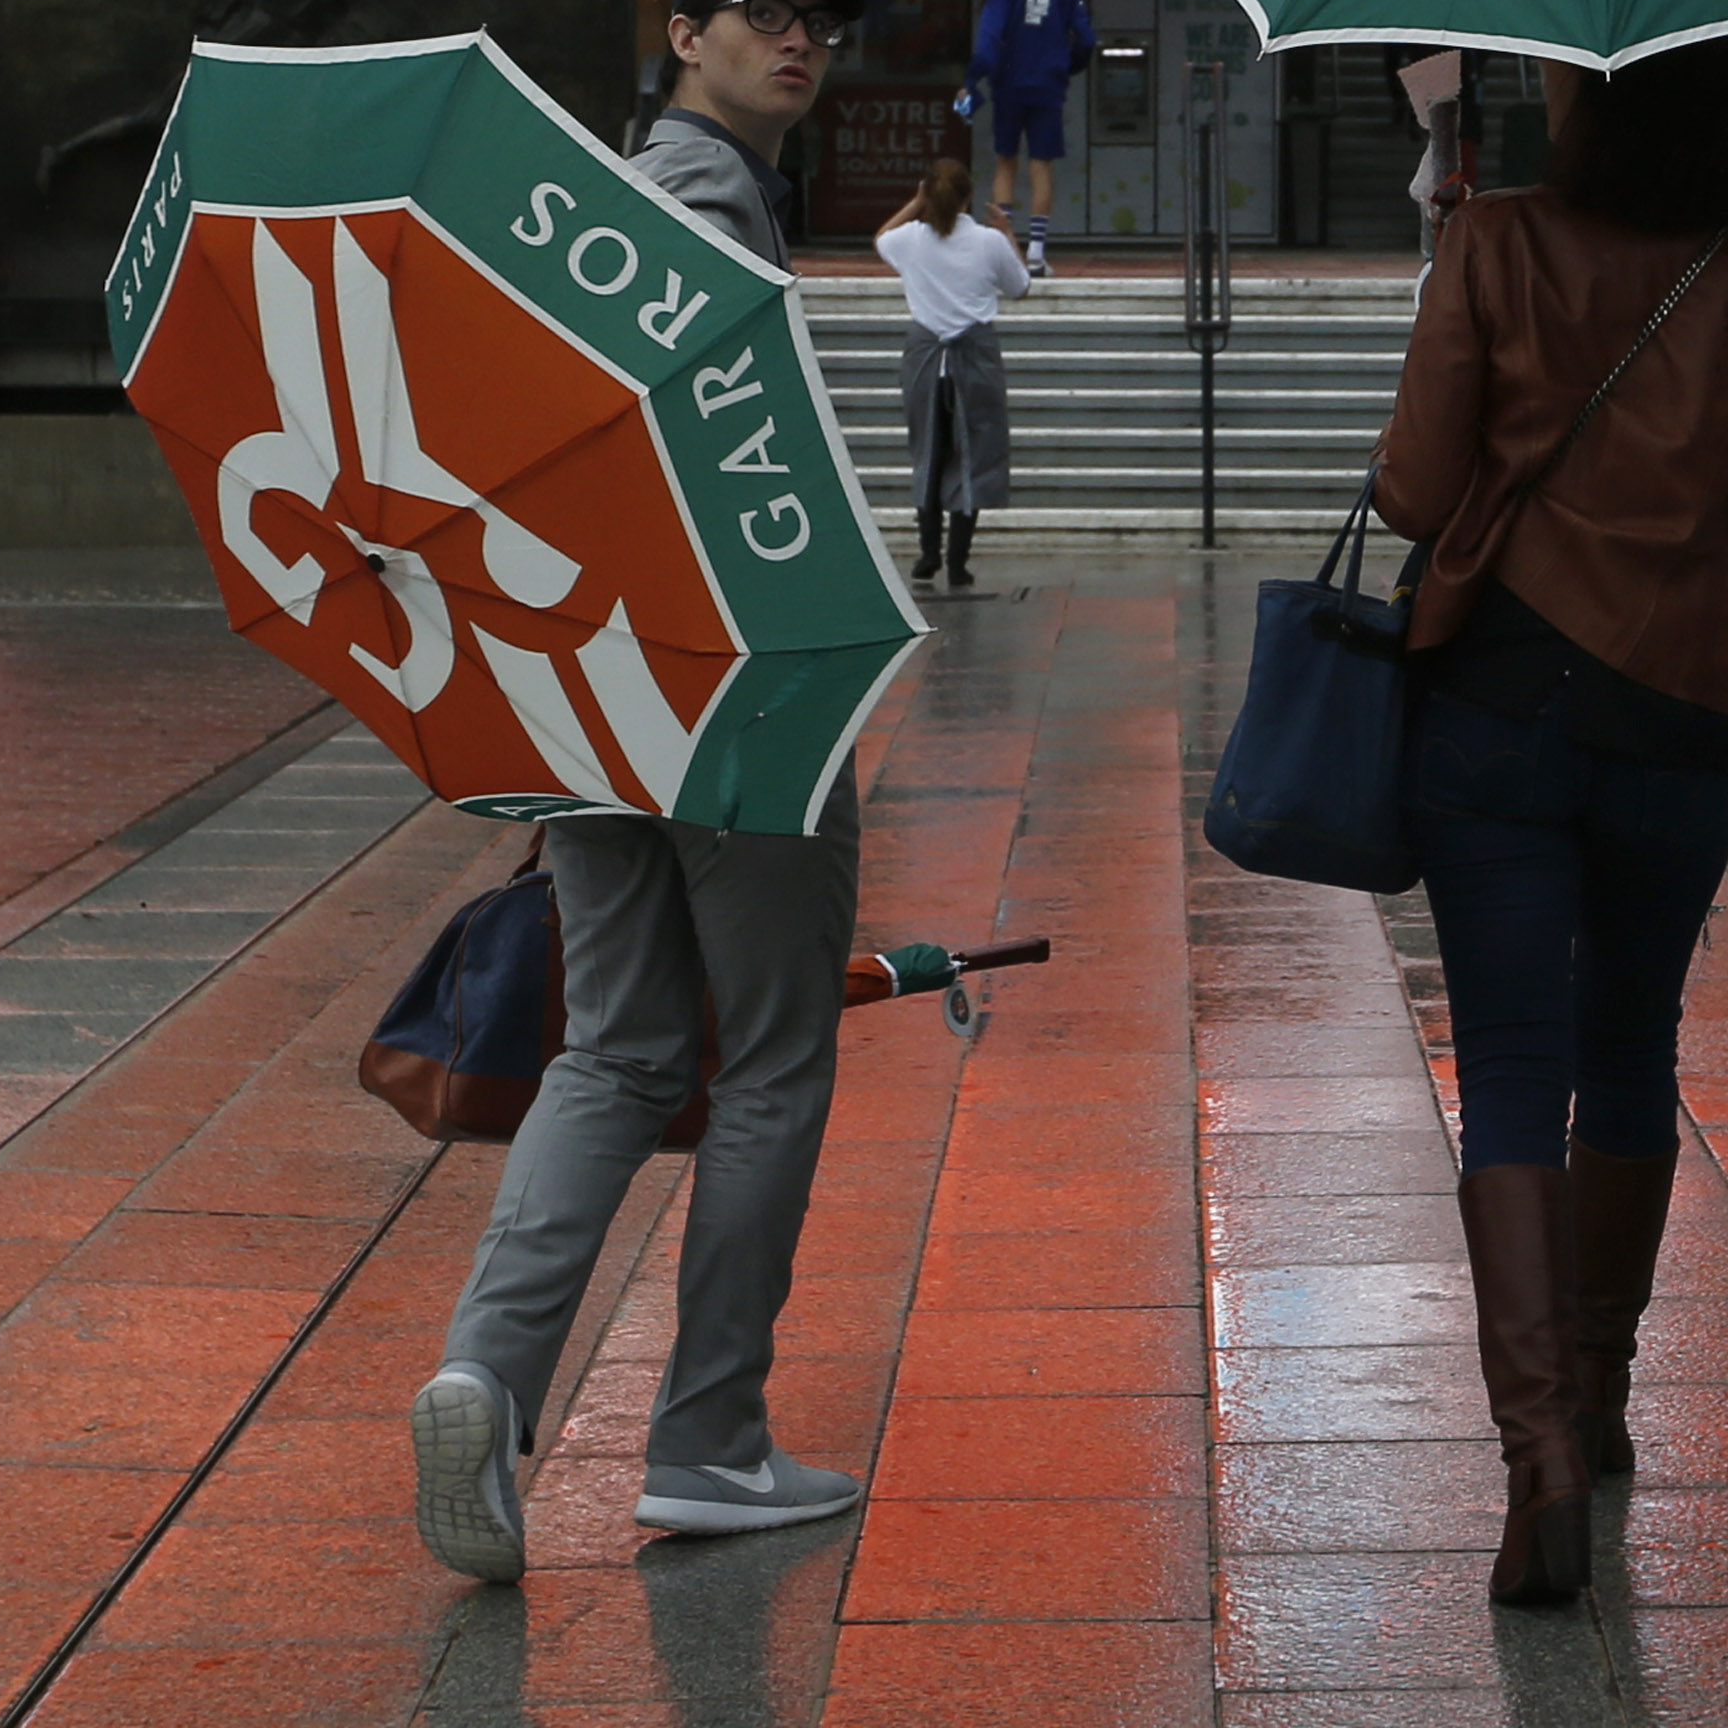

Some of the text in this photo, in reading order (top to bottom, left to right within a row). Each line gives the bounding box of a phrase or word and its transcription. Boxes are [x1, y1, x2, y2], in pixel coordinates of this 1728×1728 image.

[837, 100, 945, 125] VOTRE
[835, 128, 945, 153] BILLET
[122, 150, 183, 322] PARIS
